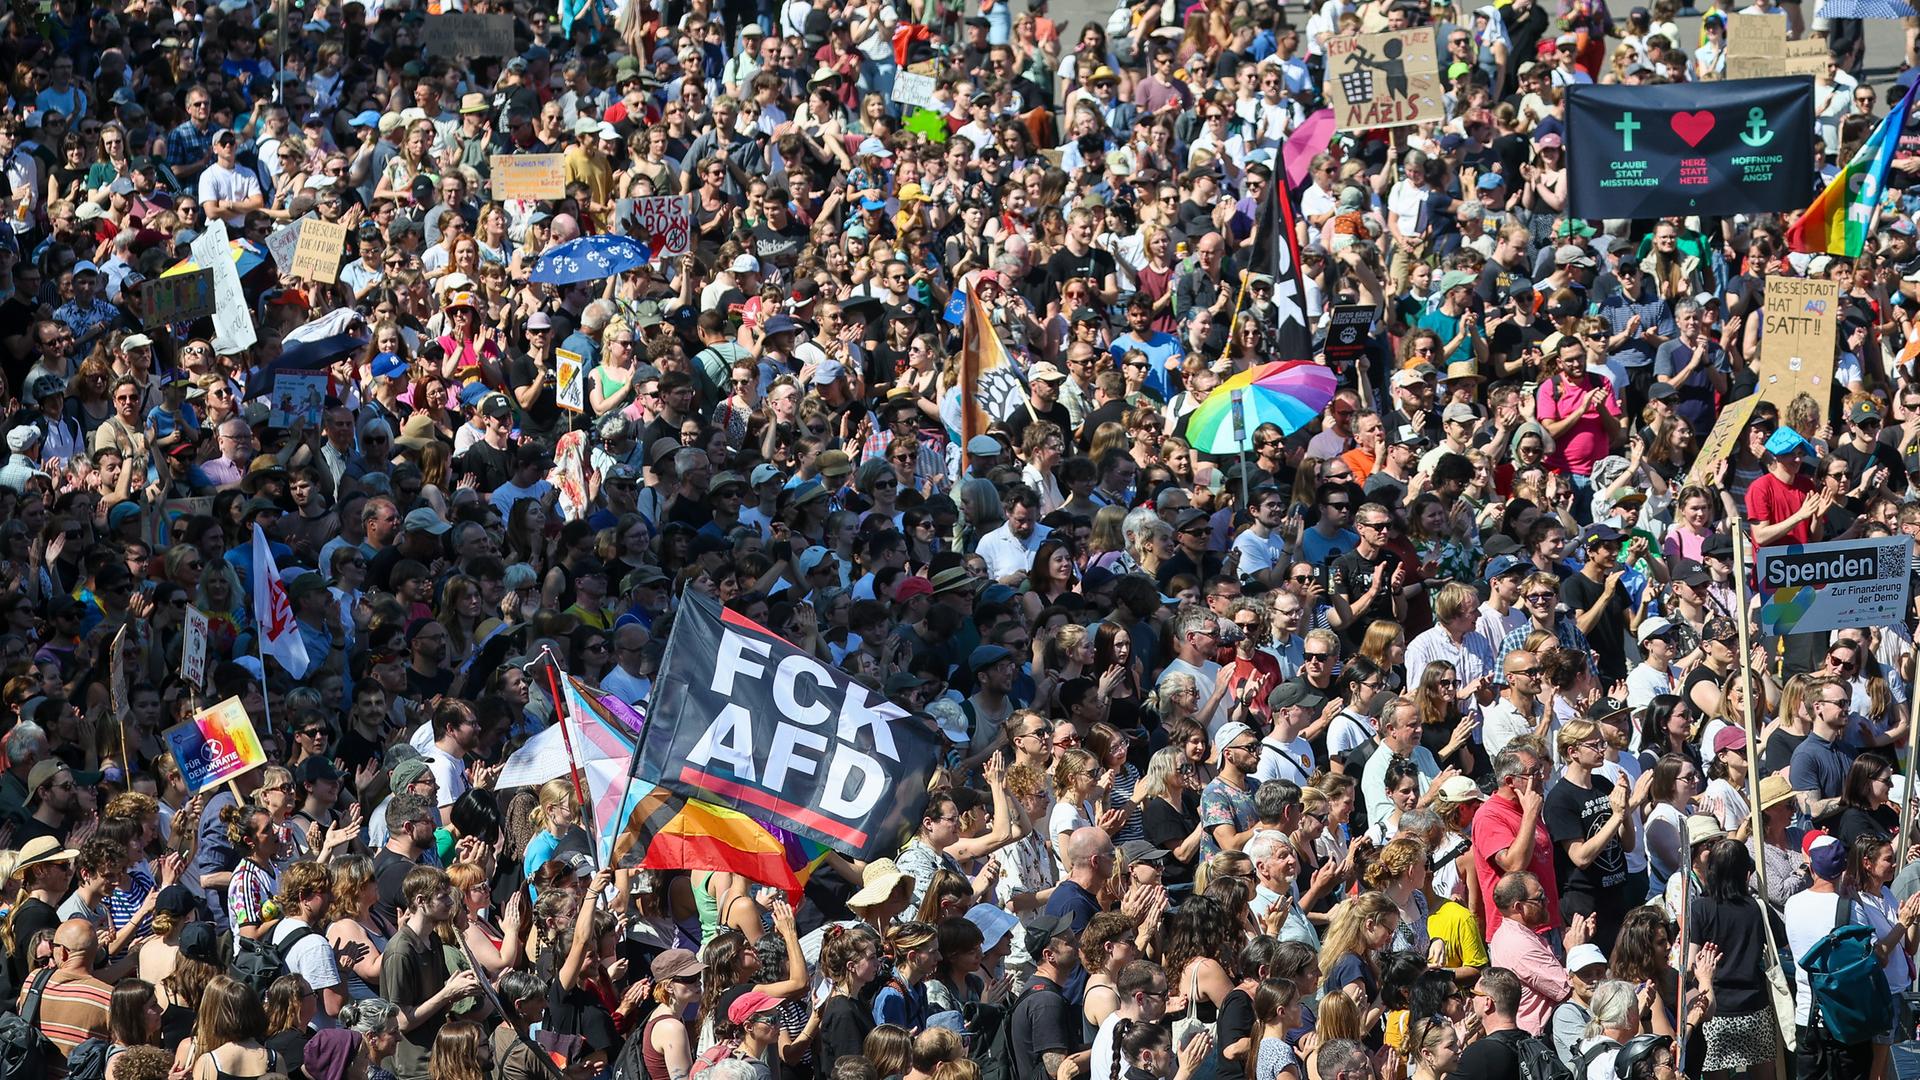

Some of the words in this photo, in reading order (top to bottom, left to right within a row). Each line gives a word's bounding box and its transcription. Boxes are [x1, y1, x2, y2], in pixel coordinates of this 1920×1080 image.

[1328, 38, 1357, 56] KEIN
[1346, 94, 1420, 126] NAZIS
[1610, 161, 1647, 171] GLAUBE
[1680, 158, 1706, 168] HERZ
[1731, 155, 1783, 166] HOFFNUNG
[1615, 169, 1643, 179] STATT
[1680, 167, 1707, 176] STATT
[1743, 164, 1770, 174] STATT
[1600, 178, 1659, 188] MISSTRAUEN
[1679, 175, 1709, 185] HETZE
[1742, 173, 1773, 182] ANGST
[633, 197, 683, 216] NAZIS
[1768, 297, 1792, 312] HAT
[1766, 315, 1821, 336] SATT!!
[1768, 554, 1873, 588] Spenden
[1832, 586, 1846, 597] Zur
[1848, 582, 1902, 595] Finanzierung
[1858, 595, 1871, 604] der
[1874, 593, 1899, 603] Demo
[710, 627, 912, 763] FCK
[185, 758, 201, 771] FÜR
[188, 751, 239, 780] DEMOKRATIE
[685, 702, 886, 820] AFD
